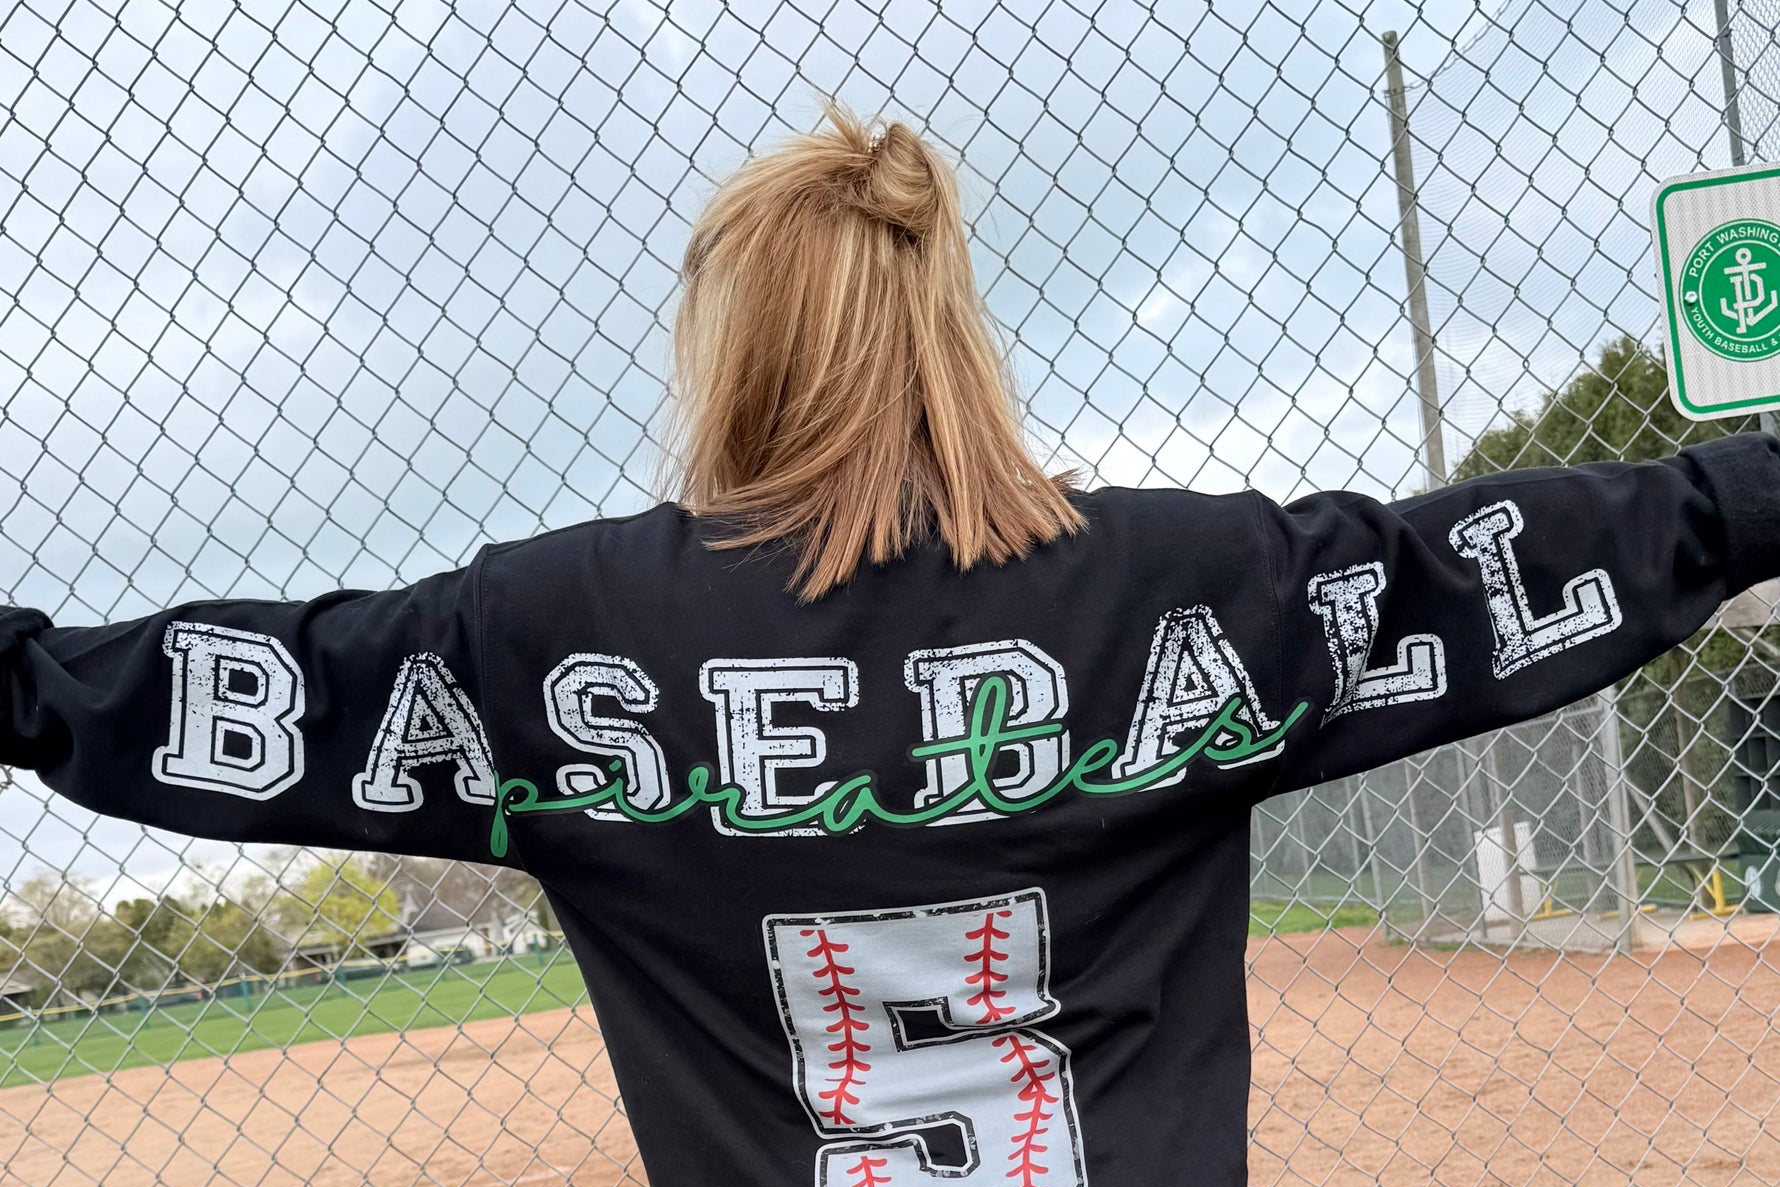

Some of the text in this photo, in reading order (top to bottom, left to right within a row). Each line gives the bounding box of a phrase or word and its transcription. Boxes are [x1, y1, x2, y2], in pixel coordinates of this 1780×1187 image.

[1688, 226, 1780, 278] PORT WASHING
[1690, 306, 1715, 340] YOUTH
[1713, 336, 1769, 354] BASEBALL
[151, 499, 1623, 837] BASEBALL
[491, 675, 1310, 858] pirates
